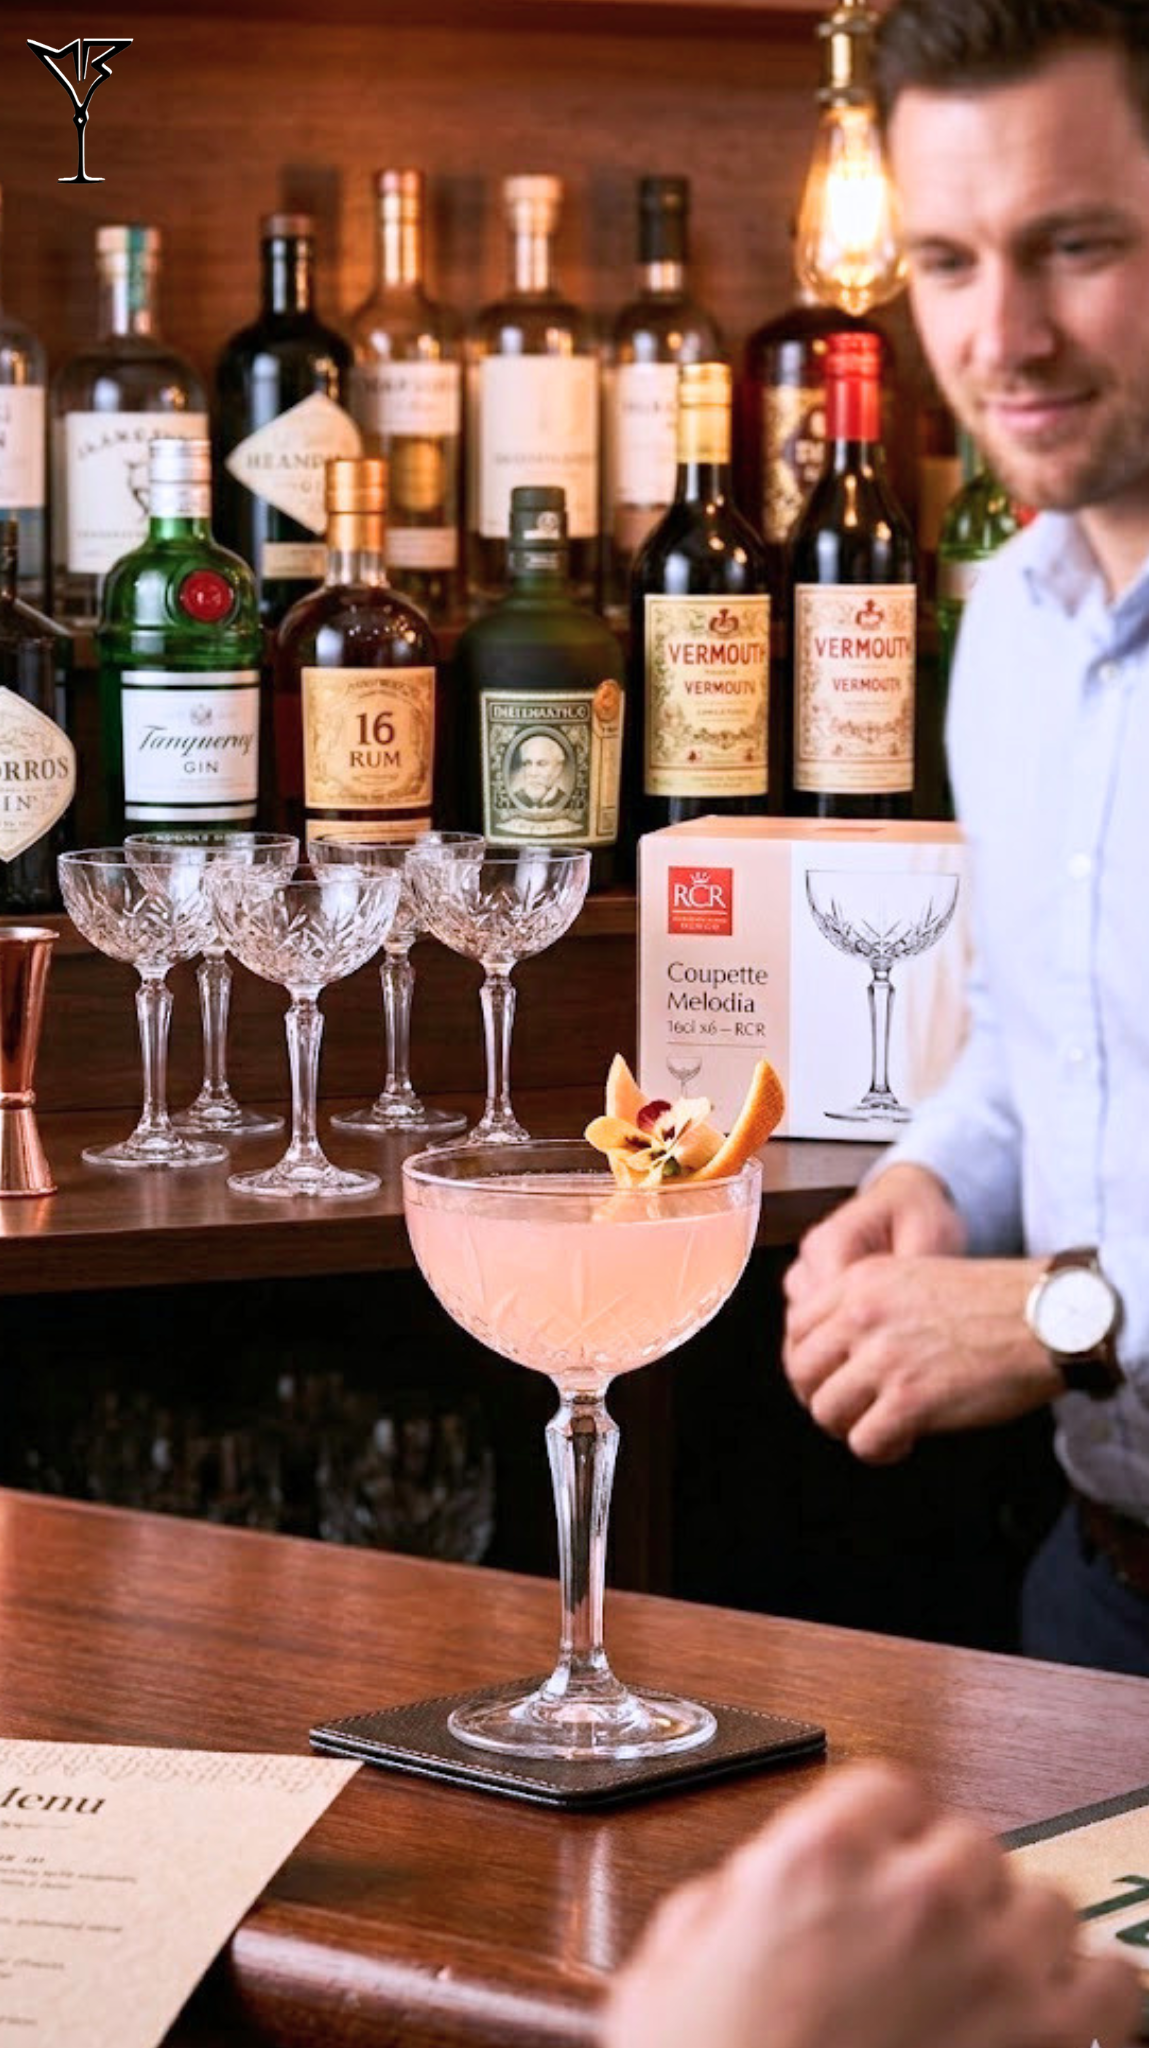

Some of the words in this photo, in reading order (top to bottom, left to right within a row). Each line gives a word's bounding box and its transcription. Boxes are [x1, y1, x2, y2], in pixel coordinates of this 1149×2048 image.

[356, 711, 396, 746] 16
[0, 756, 69, 781] RROS
[184, 762, 220, 774] GIN
[350, 751, 402, 769] RUM
[3, 795, 38, 812] IN
[674, 884, 727, 909] RCR
[667, 961, 769, 990] Coupette
[667, 992, 756, 1014] Melodia
[735, 1022, 766, 1037] RCR
